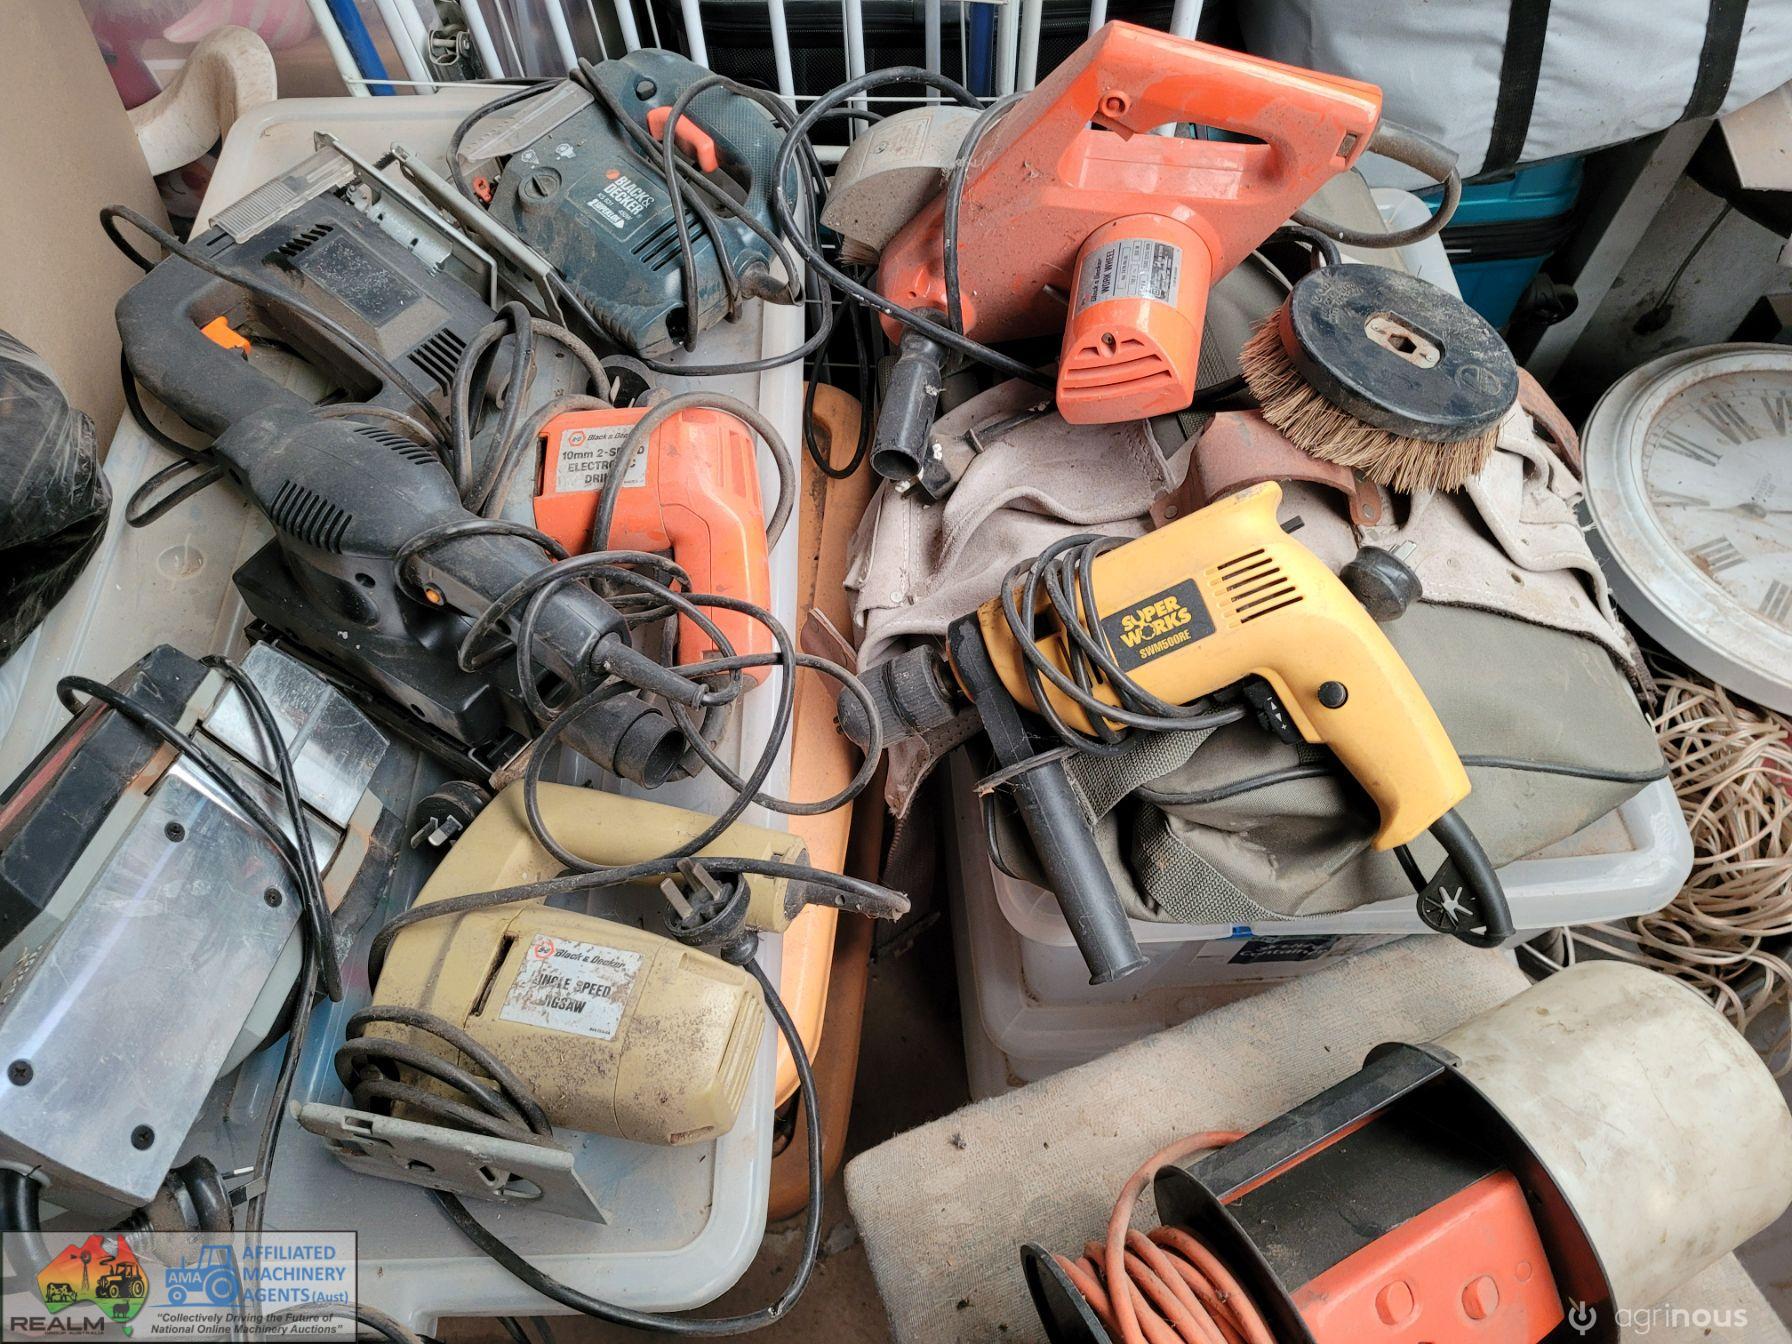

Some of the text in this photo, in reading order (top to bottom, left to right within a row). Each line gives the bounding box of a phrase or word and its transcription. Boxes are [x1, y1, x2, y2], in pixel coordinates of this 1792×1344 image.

[603, 182, 645, 216] DECKER
[1101, 248, 1115, 295] WORK WHEEL
[587, 432, 606, 441] Black
[562, 451, 593, 460] 10mm
[1120, 607, 1192, 648] WORKS
[1121, 595, 1181, 632] SUPER
[1139, 629, 1192, 659] SWM500RE
[554, 948, 583, 961] Black
[590, 955, 626, 969] Decker
